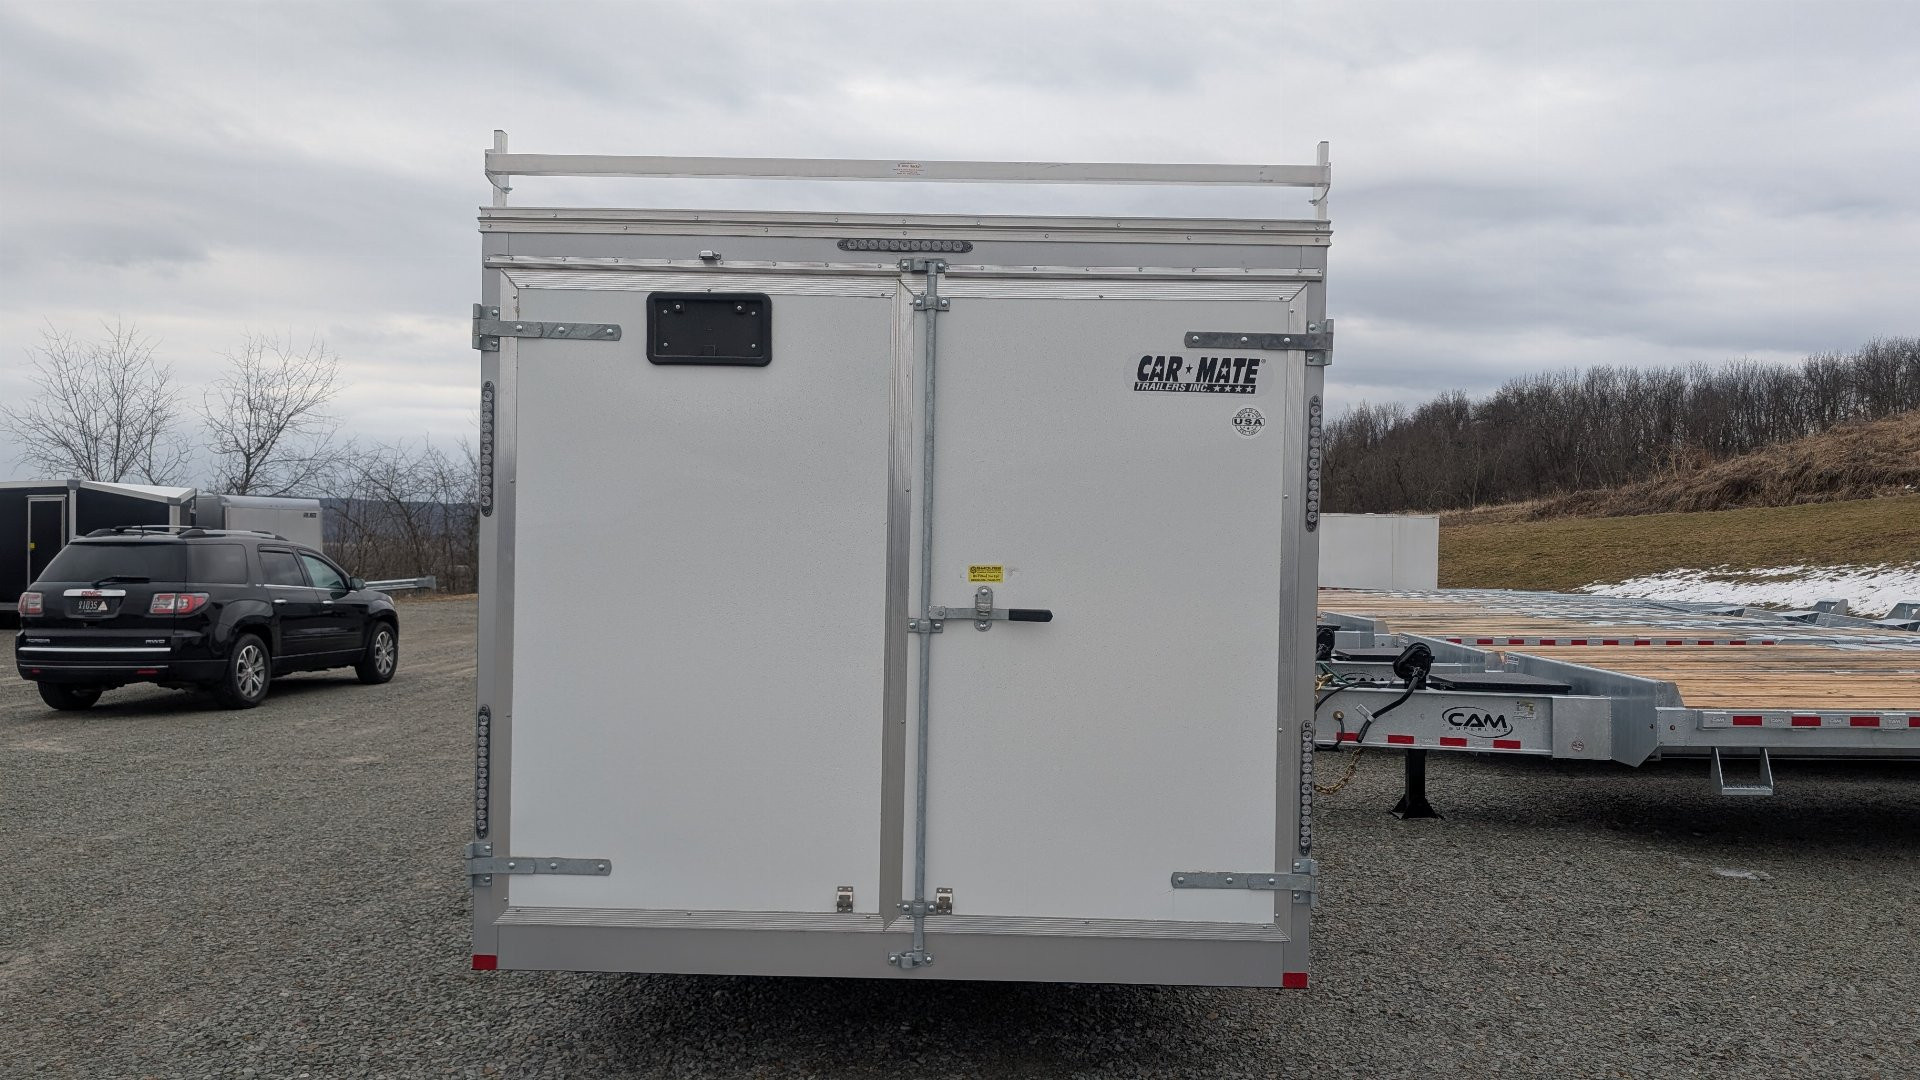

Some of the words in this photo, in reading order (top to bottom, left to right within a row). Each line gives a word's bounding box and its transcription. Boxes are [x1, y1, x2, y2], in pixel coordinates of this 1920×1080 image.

[1137, 355, 1183, 382] CAR
[1195, 357, 1260, 384] MATE
[1136, 382, 1187, 392] TRAILERS
[1189, 384, 1211, 392] INC.
[1233, 418, 1262, 426] USA
[1448, 713, 1507, 728] CAM
